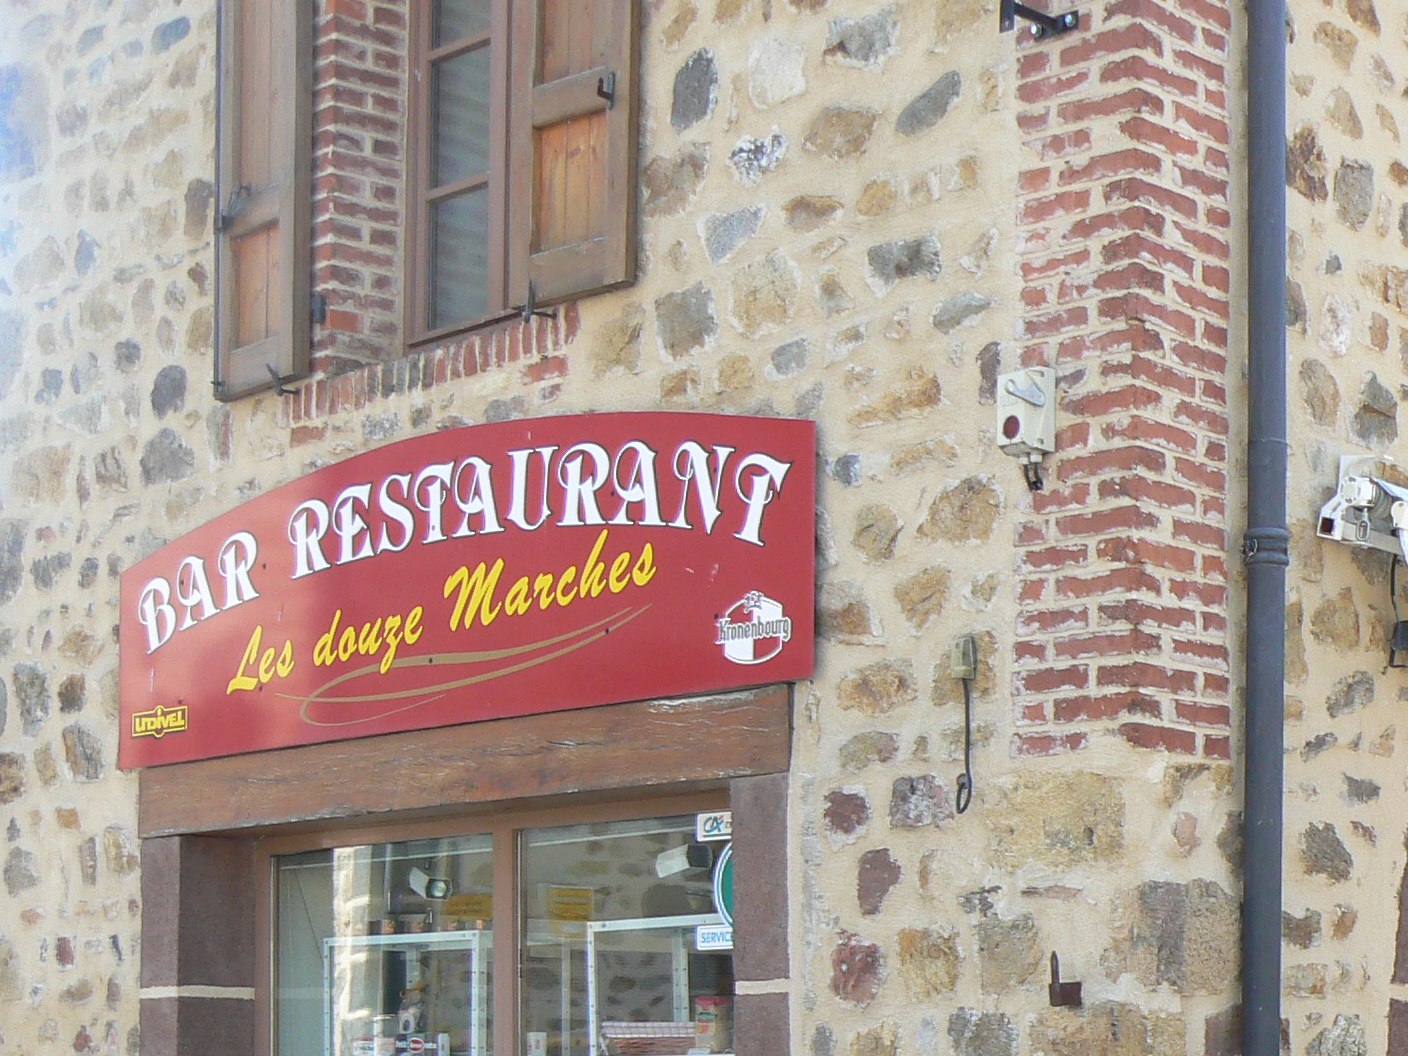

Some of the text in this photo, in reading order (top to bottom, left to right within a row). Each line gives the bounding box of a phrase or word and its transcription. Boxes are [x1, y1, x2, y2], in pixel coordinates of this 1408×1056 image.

[138, 440, 793, 655] BAR RESTAURANT
[226, 528, 657, 696] Les douze Marches
[716, 615, 792, 644] Kronenbourg
